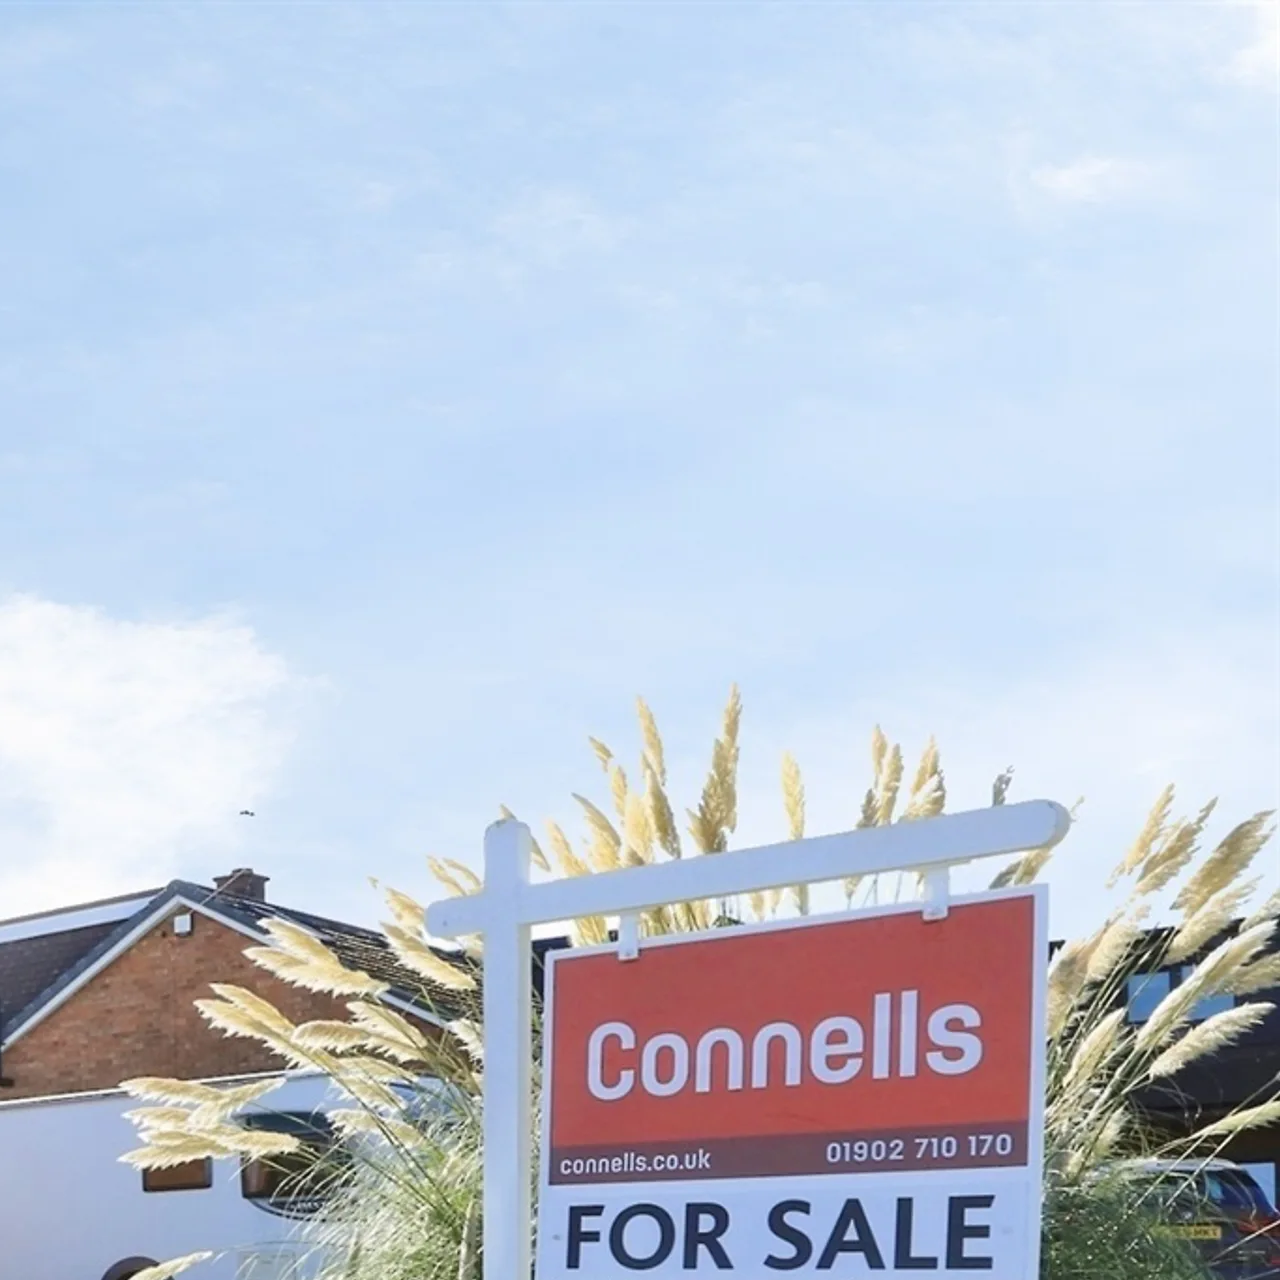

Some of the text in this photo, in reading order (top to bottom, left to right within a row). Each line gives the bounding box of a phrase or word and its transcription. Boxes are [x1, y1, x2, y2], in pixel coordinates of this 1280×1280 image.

[587, 990, 983, 1100] Connells
[560, 1148, 711, 1175] connells.co.uk
[826, 1133, 1013, 1163] 01902 710 170
[566, 1194, 995, 1271] FOR SALE
